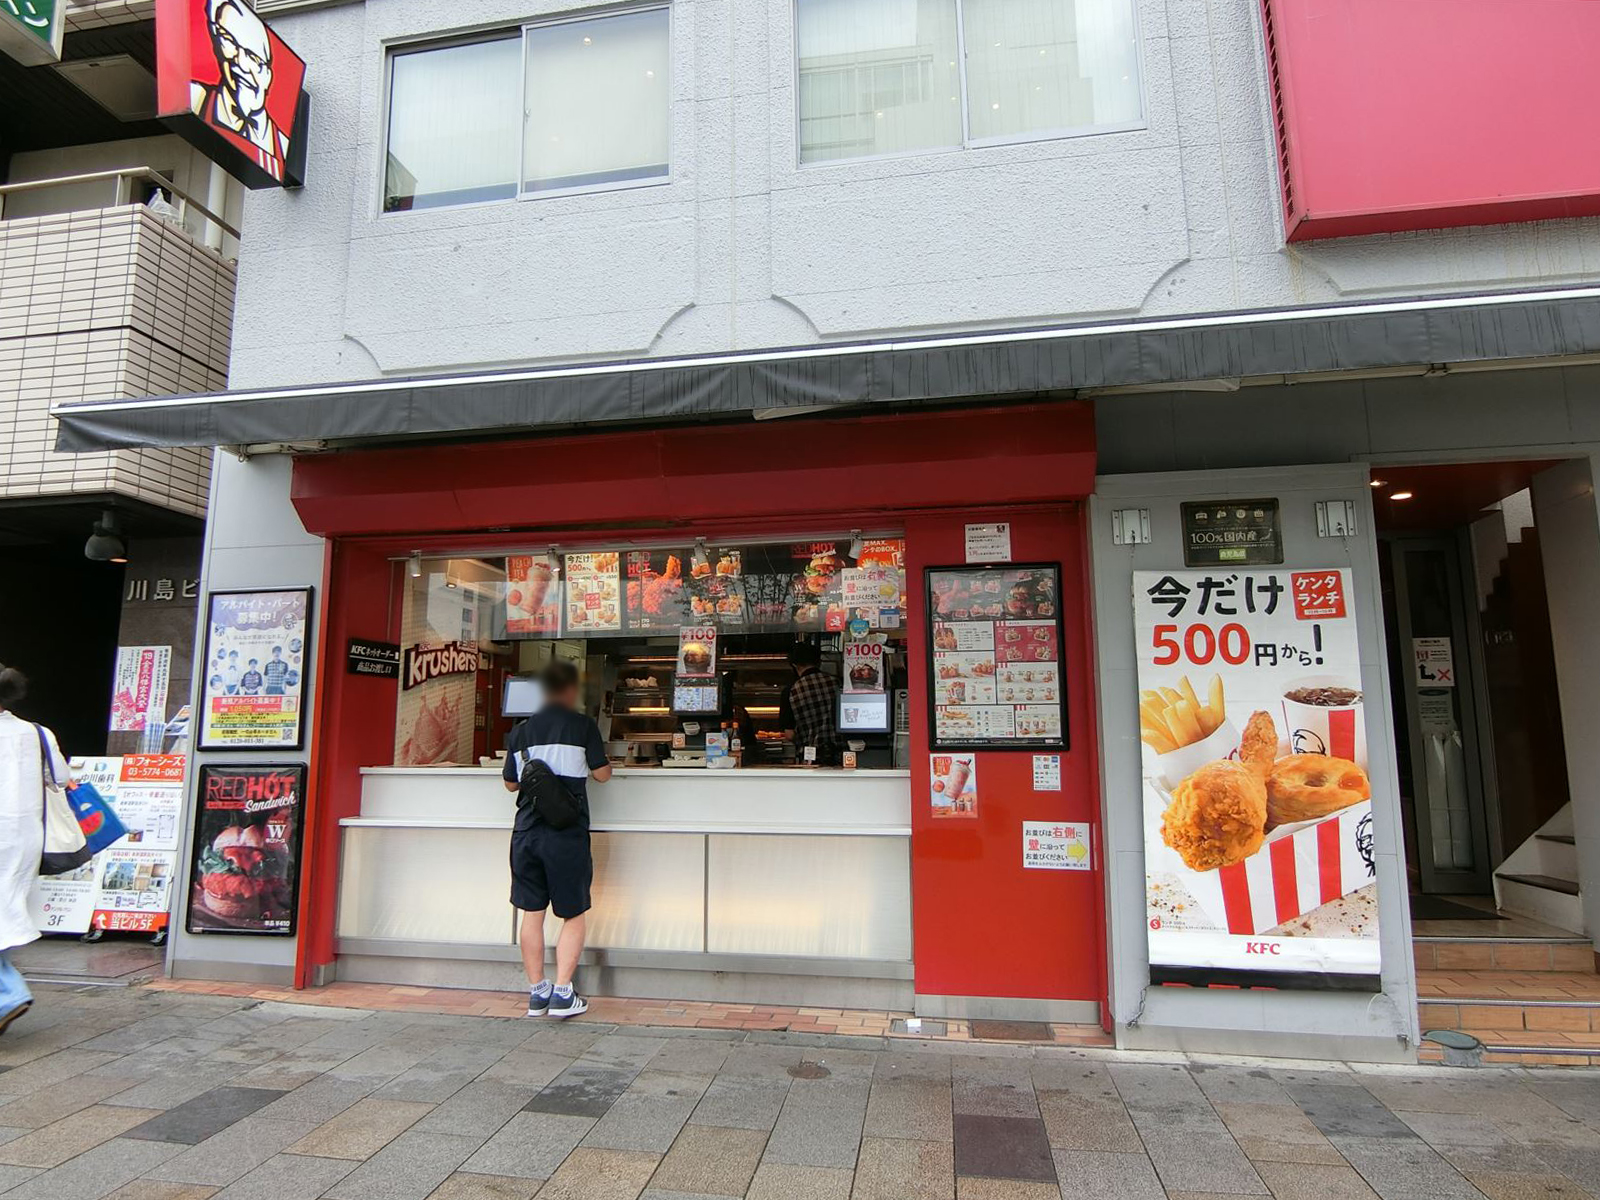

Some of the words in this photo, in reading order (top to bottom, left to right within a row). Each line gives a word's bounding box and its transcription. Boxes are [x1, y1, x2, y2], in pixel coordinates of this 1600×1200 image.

[1191, 531, 1258, 543] 100%国内産
[1296, 576, 1337, 592] ケンタ
[1147, 574, 1284, 618] 今だけ
[1298, 591, 1339, 607] ランチ
[682, 628, 715, 641] ¥100
[846, 643, 882, 656] ¥100
[410, 646, 478, 687] krushers
[243, 791, 297, 813] Sandwich
[267, 824, 286, 839] W
[1026, 826, 1083, 838] お並びは右側に
[1029, 839, 1065, 851] 壁に沿って
[1026, 853, 1068, 861] お並びください
[47, 914, 66, 927] 3F
[1246, 942, 1280, 955] KFC
